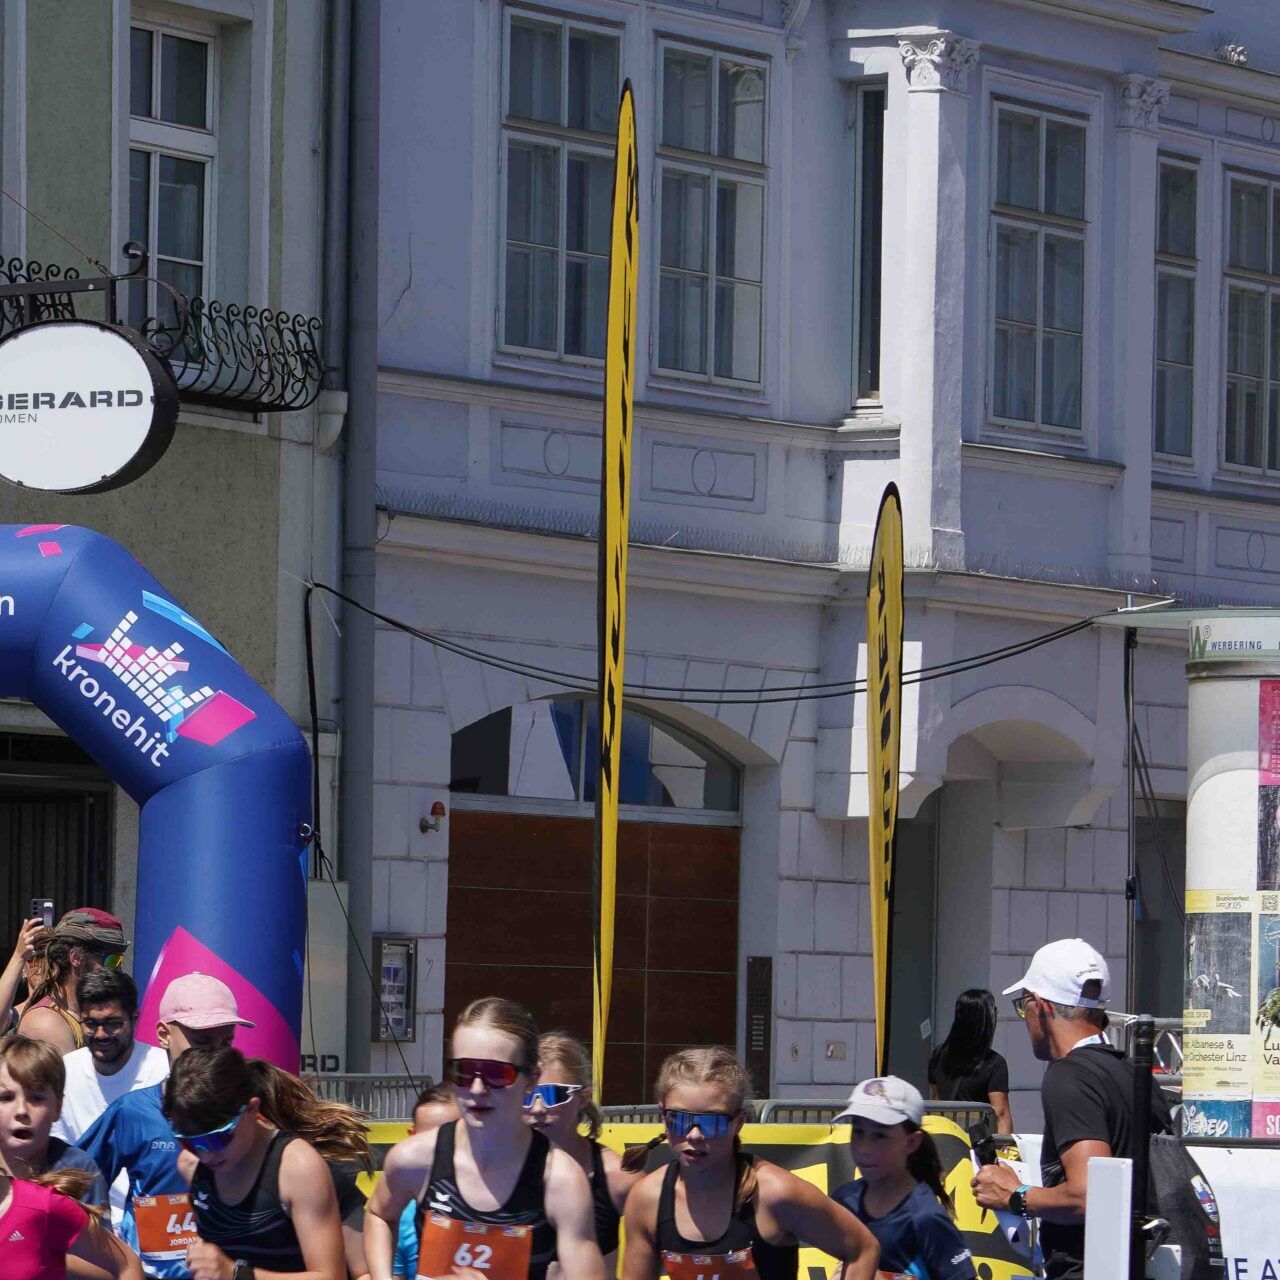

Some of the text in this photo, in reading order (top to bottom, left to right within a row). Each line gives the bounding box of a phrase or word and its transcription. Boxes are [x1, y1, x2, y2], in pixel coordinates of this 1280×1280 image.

[1210, 640, 1263, 650] WERBERING
[52, 644, 170, 768] kronehit
[1226, 1039, 1235, 1050] &
[1226, 1051, 1247, 1063] Linz
[166, 1211, 198, 1235] 44
[452, 1242, 494, 1269] 62
